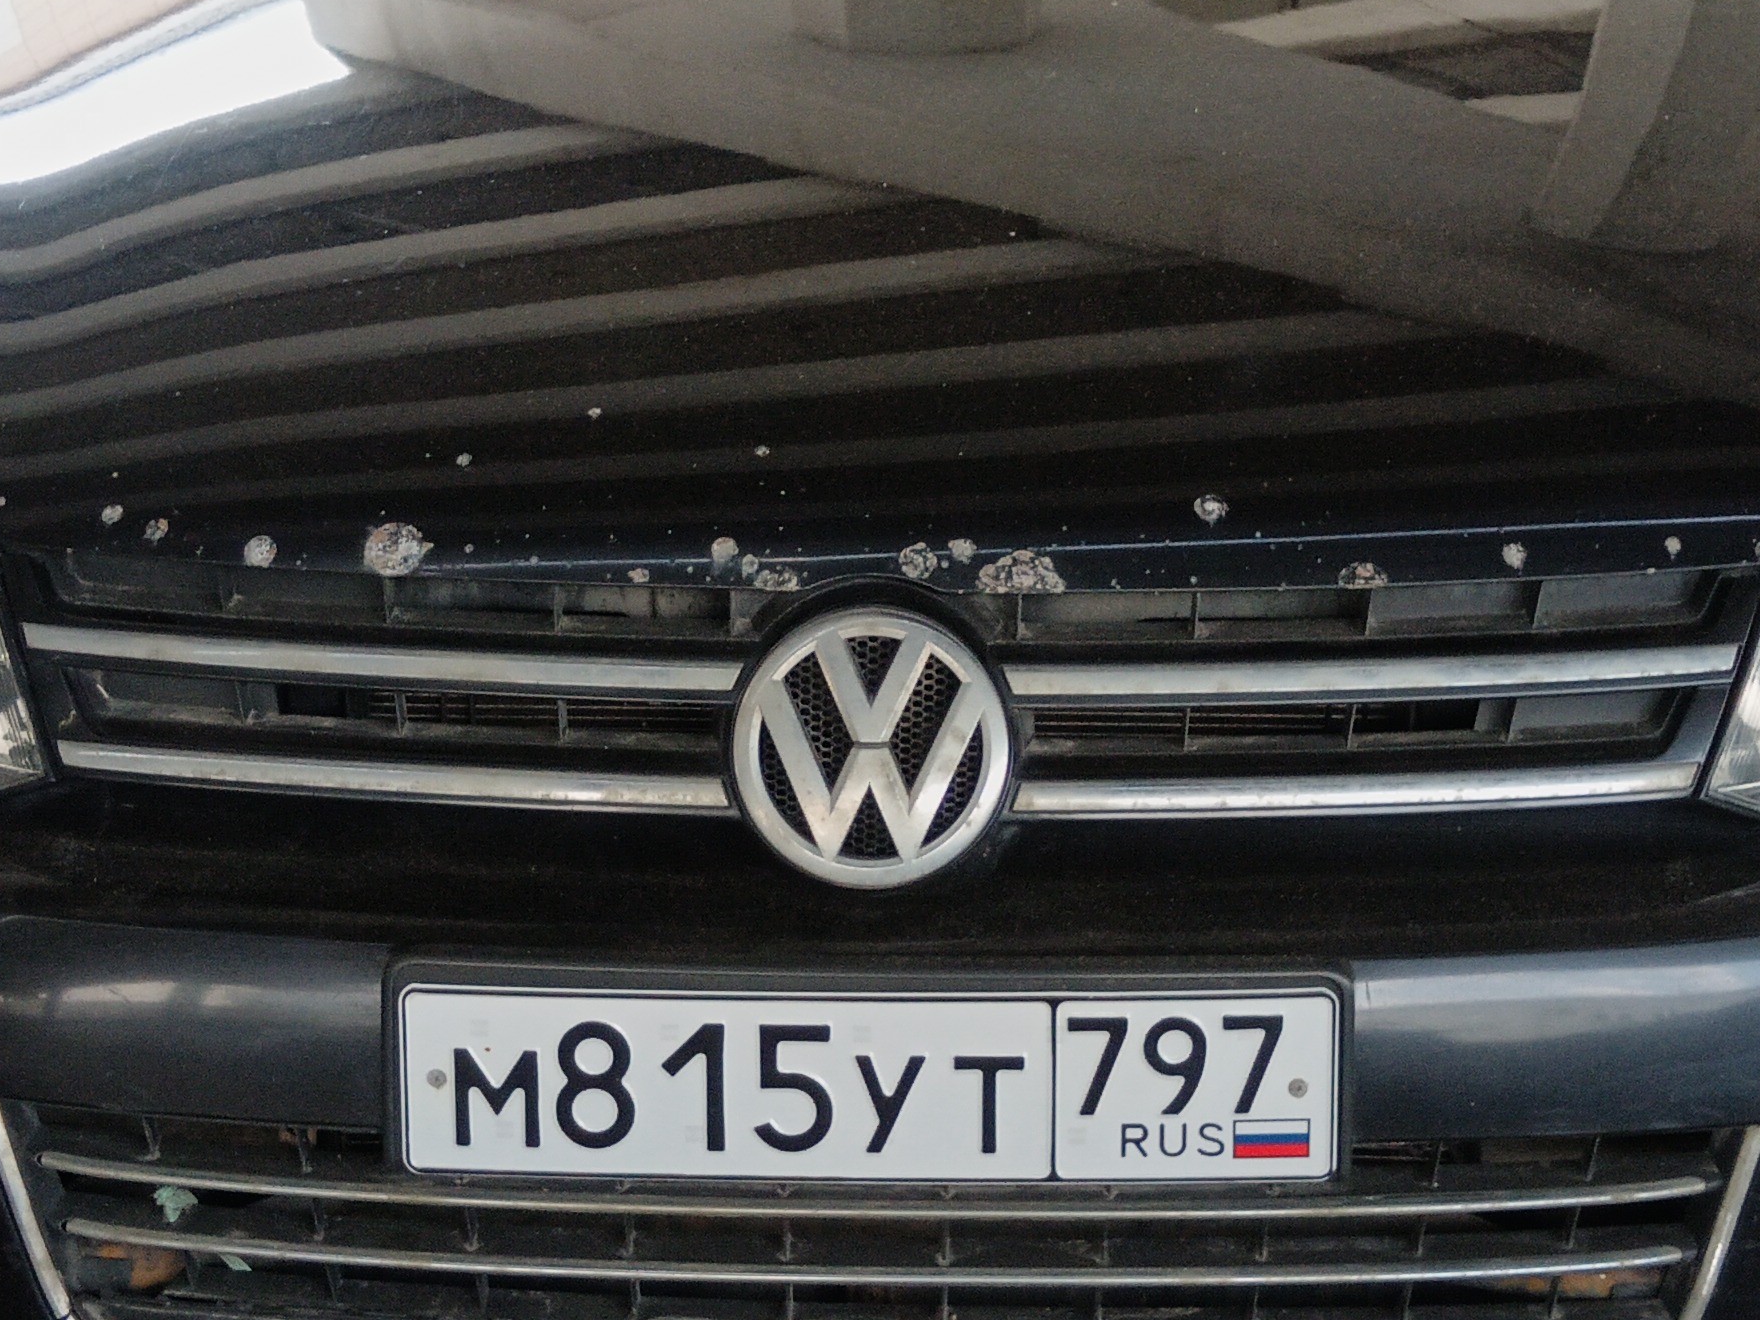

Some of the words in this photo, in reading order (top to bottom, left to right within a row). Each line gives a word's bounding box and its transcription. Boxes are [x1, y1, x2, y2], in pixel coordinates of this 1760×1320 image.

[452, 1020, 1026, 1154] М815УТ
[1066, 1014, 1284, 1117] 797
[1119, 1122, 1225, 1159] RUS
